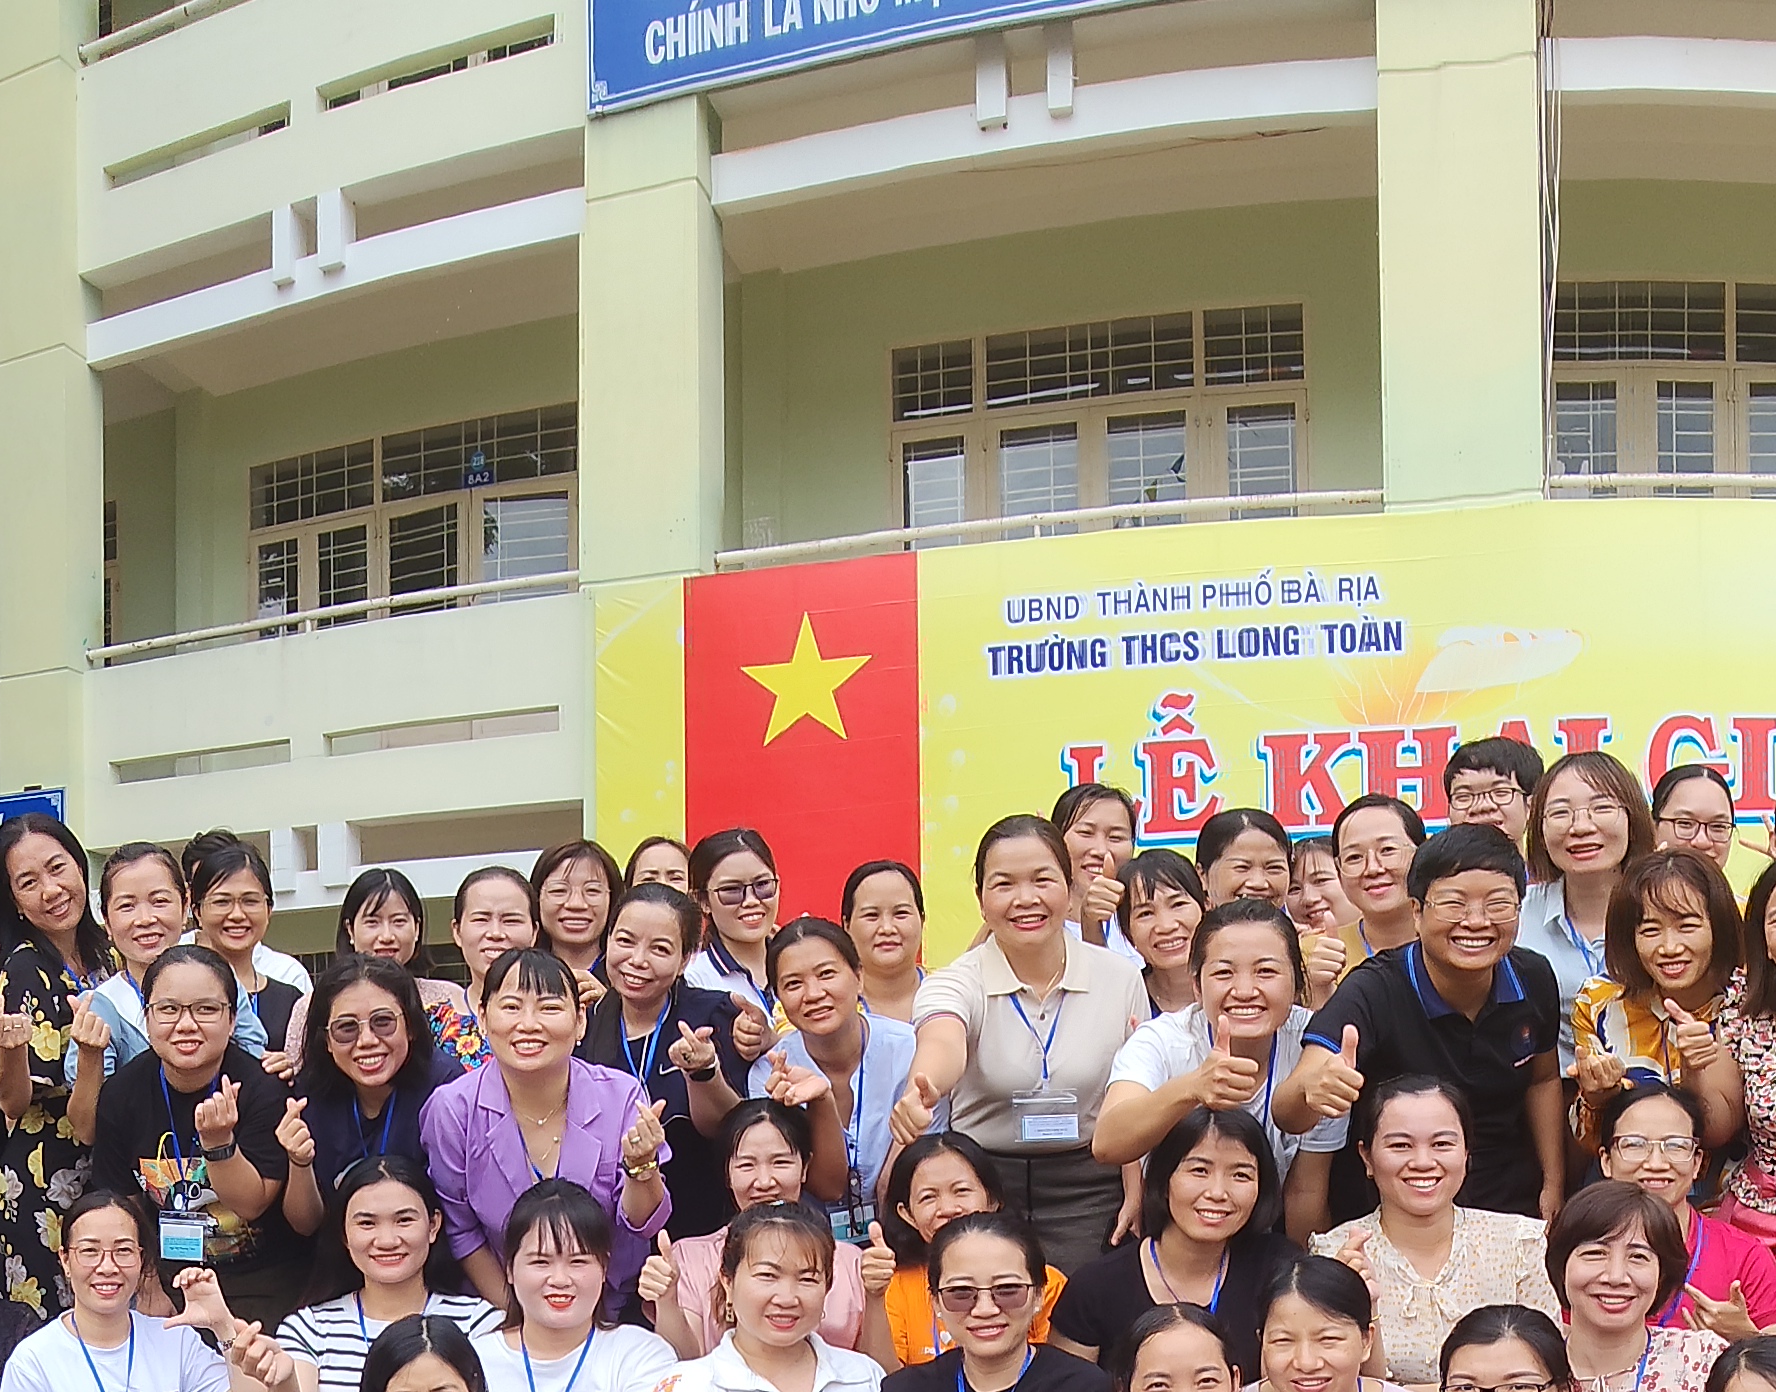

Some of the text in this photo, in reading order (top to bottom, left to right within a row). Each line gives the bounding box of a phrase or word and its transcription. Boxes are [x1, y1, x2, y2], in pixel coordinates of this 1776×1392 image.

[468, 472, 489, 484] 8A2
[1007, 596, 1081, 624] UBND
[1097, 582, 1192, 617] THÀNH
[1281, 571, 1323, 605] BÀ
[1337, 576, 1380, 608] RỊA
[987, 615, 1404, 677] TRƯỜNG THCS LONG TOÀN
